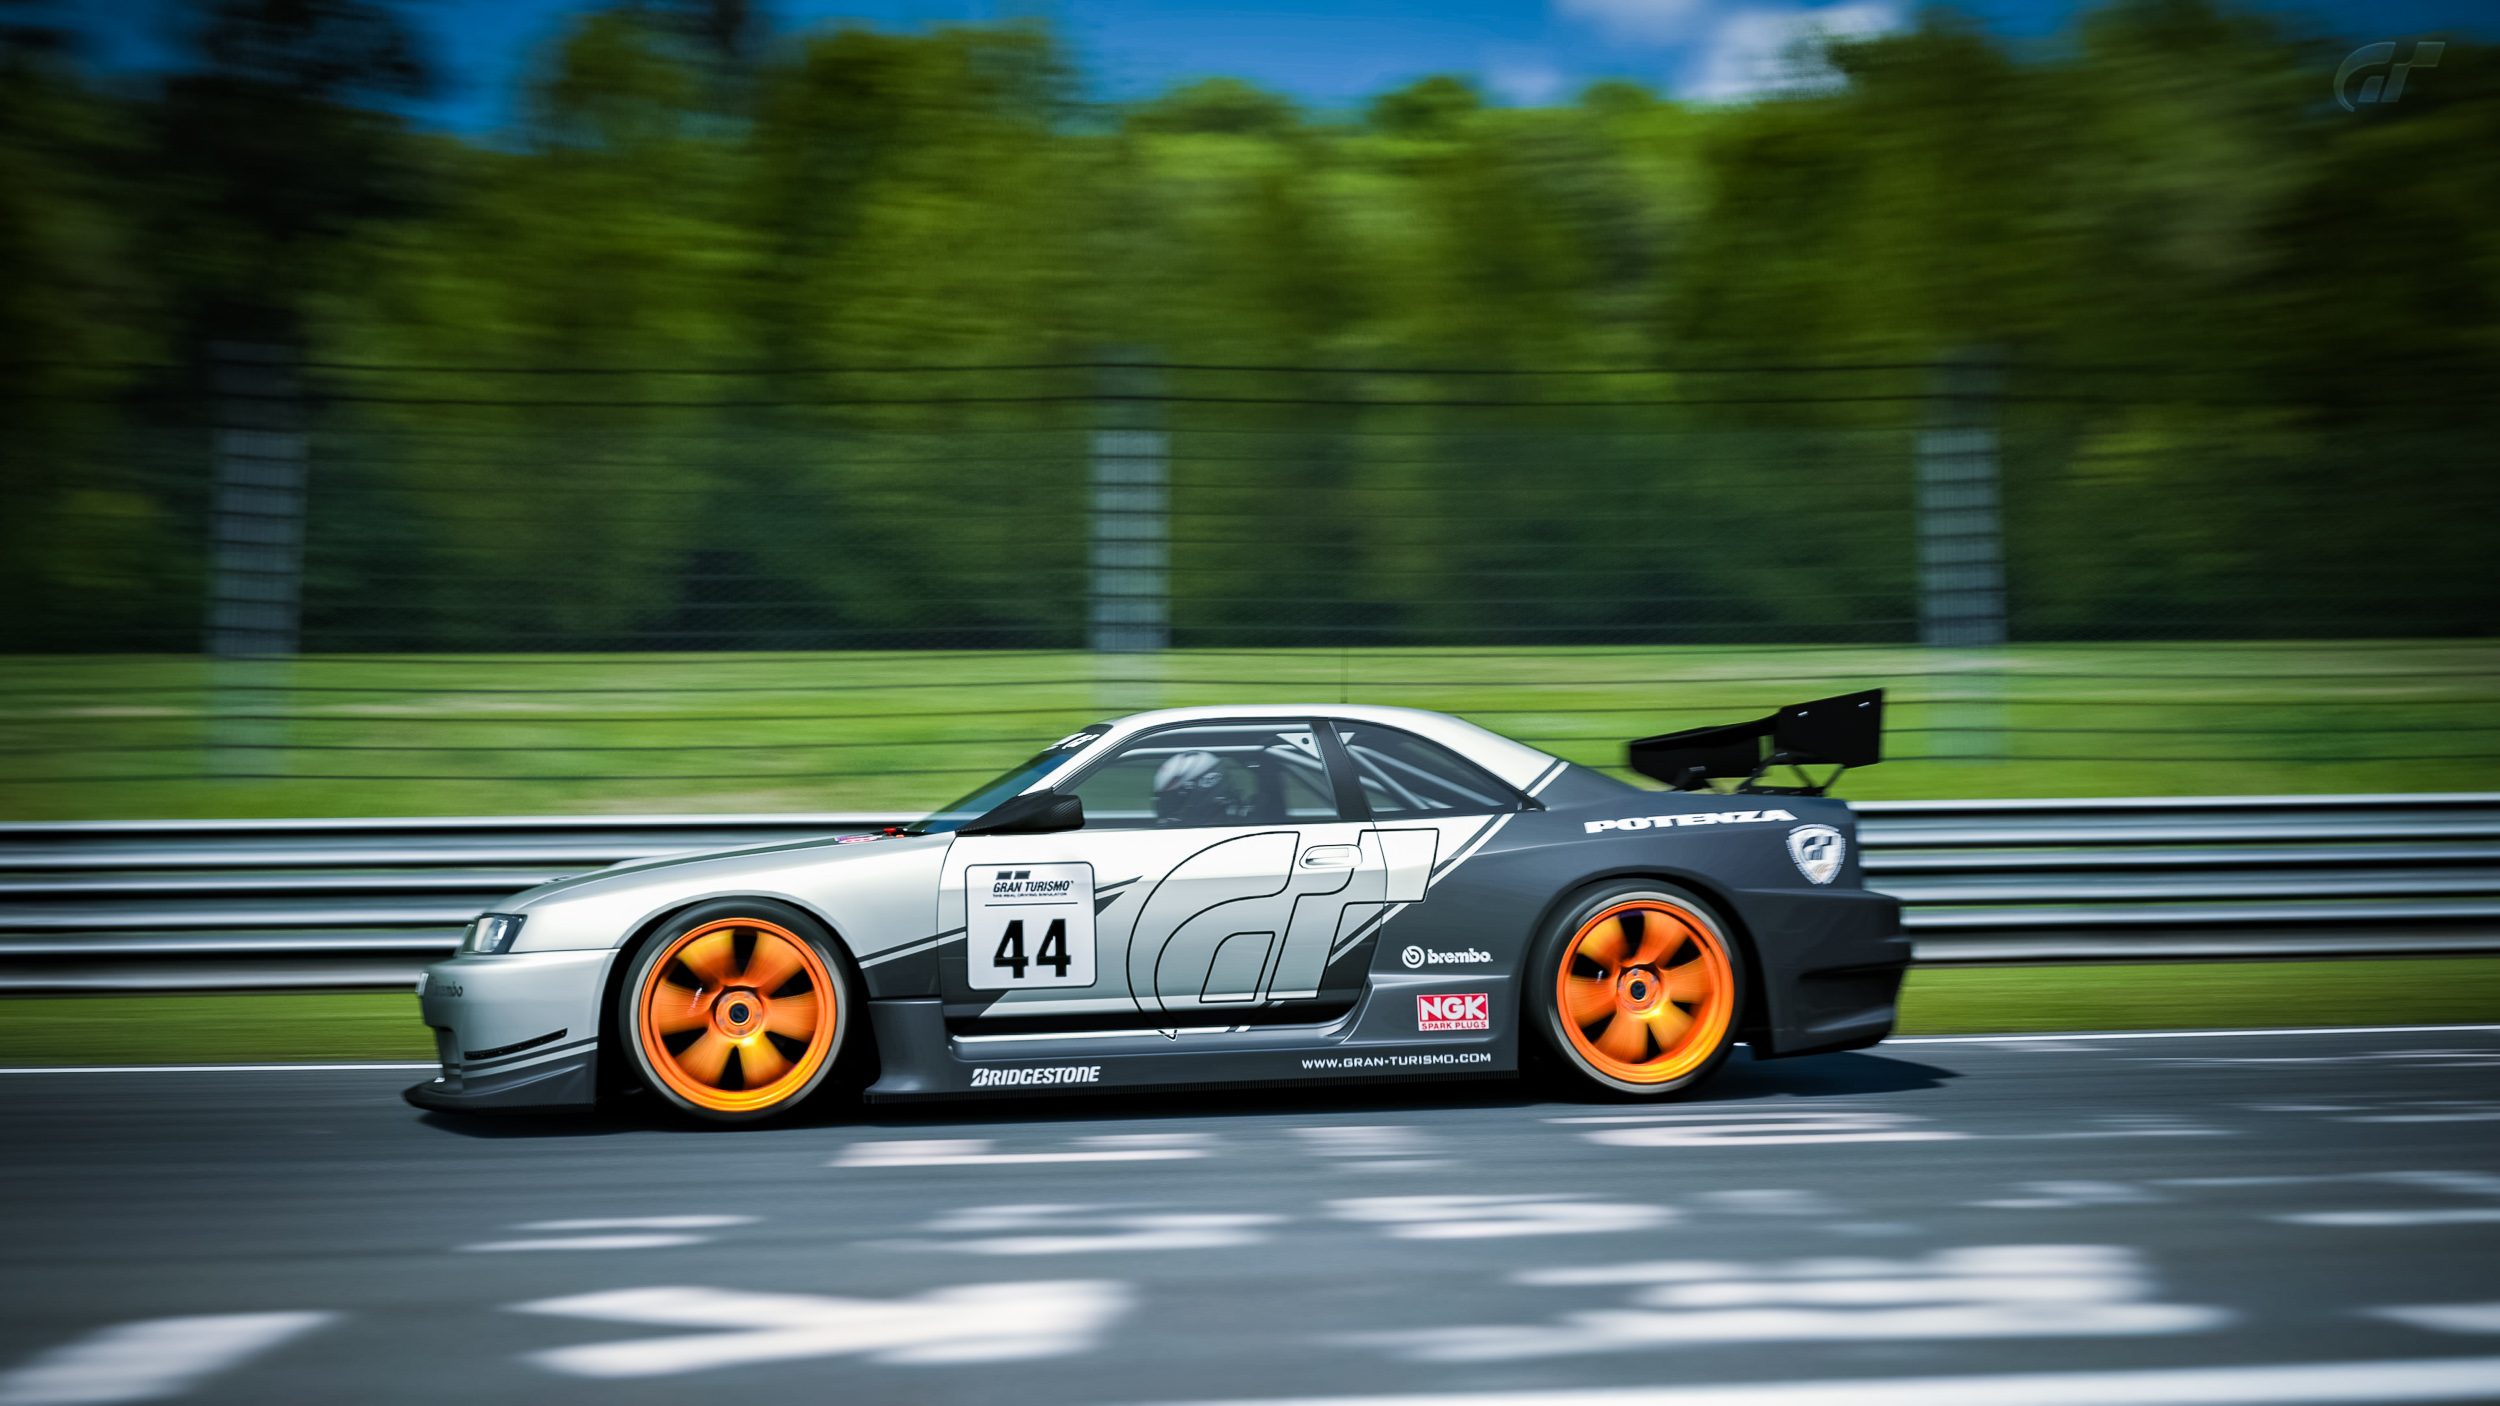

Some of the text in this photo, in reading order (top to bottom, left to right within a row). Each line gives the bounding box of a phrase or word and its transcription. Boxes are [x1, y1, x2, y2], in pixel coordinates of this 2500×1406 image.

[1584, 809, 1798, 834] POTENZA
[993, 880, 1070, 893] GRAN TURISMO
[993, 918, 1071, 979] 44
[1427, 948, 1493, 964] brembo
[1420, 996, 1486, 1020] NGK
[1422, 1021, 1486, 1030] SPARK PLUGS
[1302, 1053, 1491, 1069] WWW.GRAN-TURISMO.COM
[970, 1066, 1101, 1087] BRIDGESTONE
